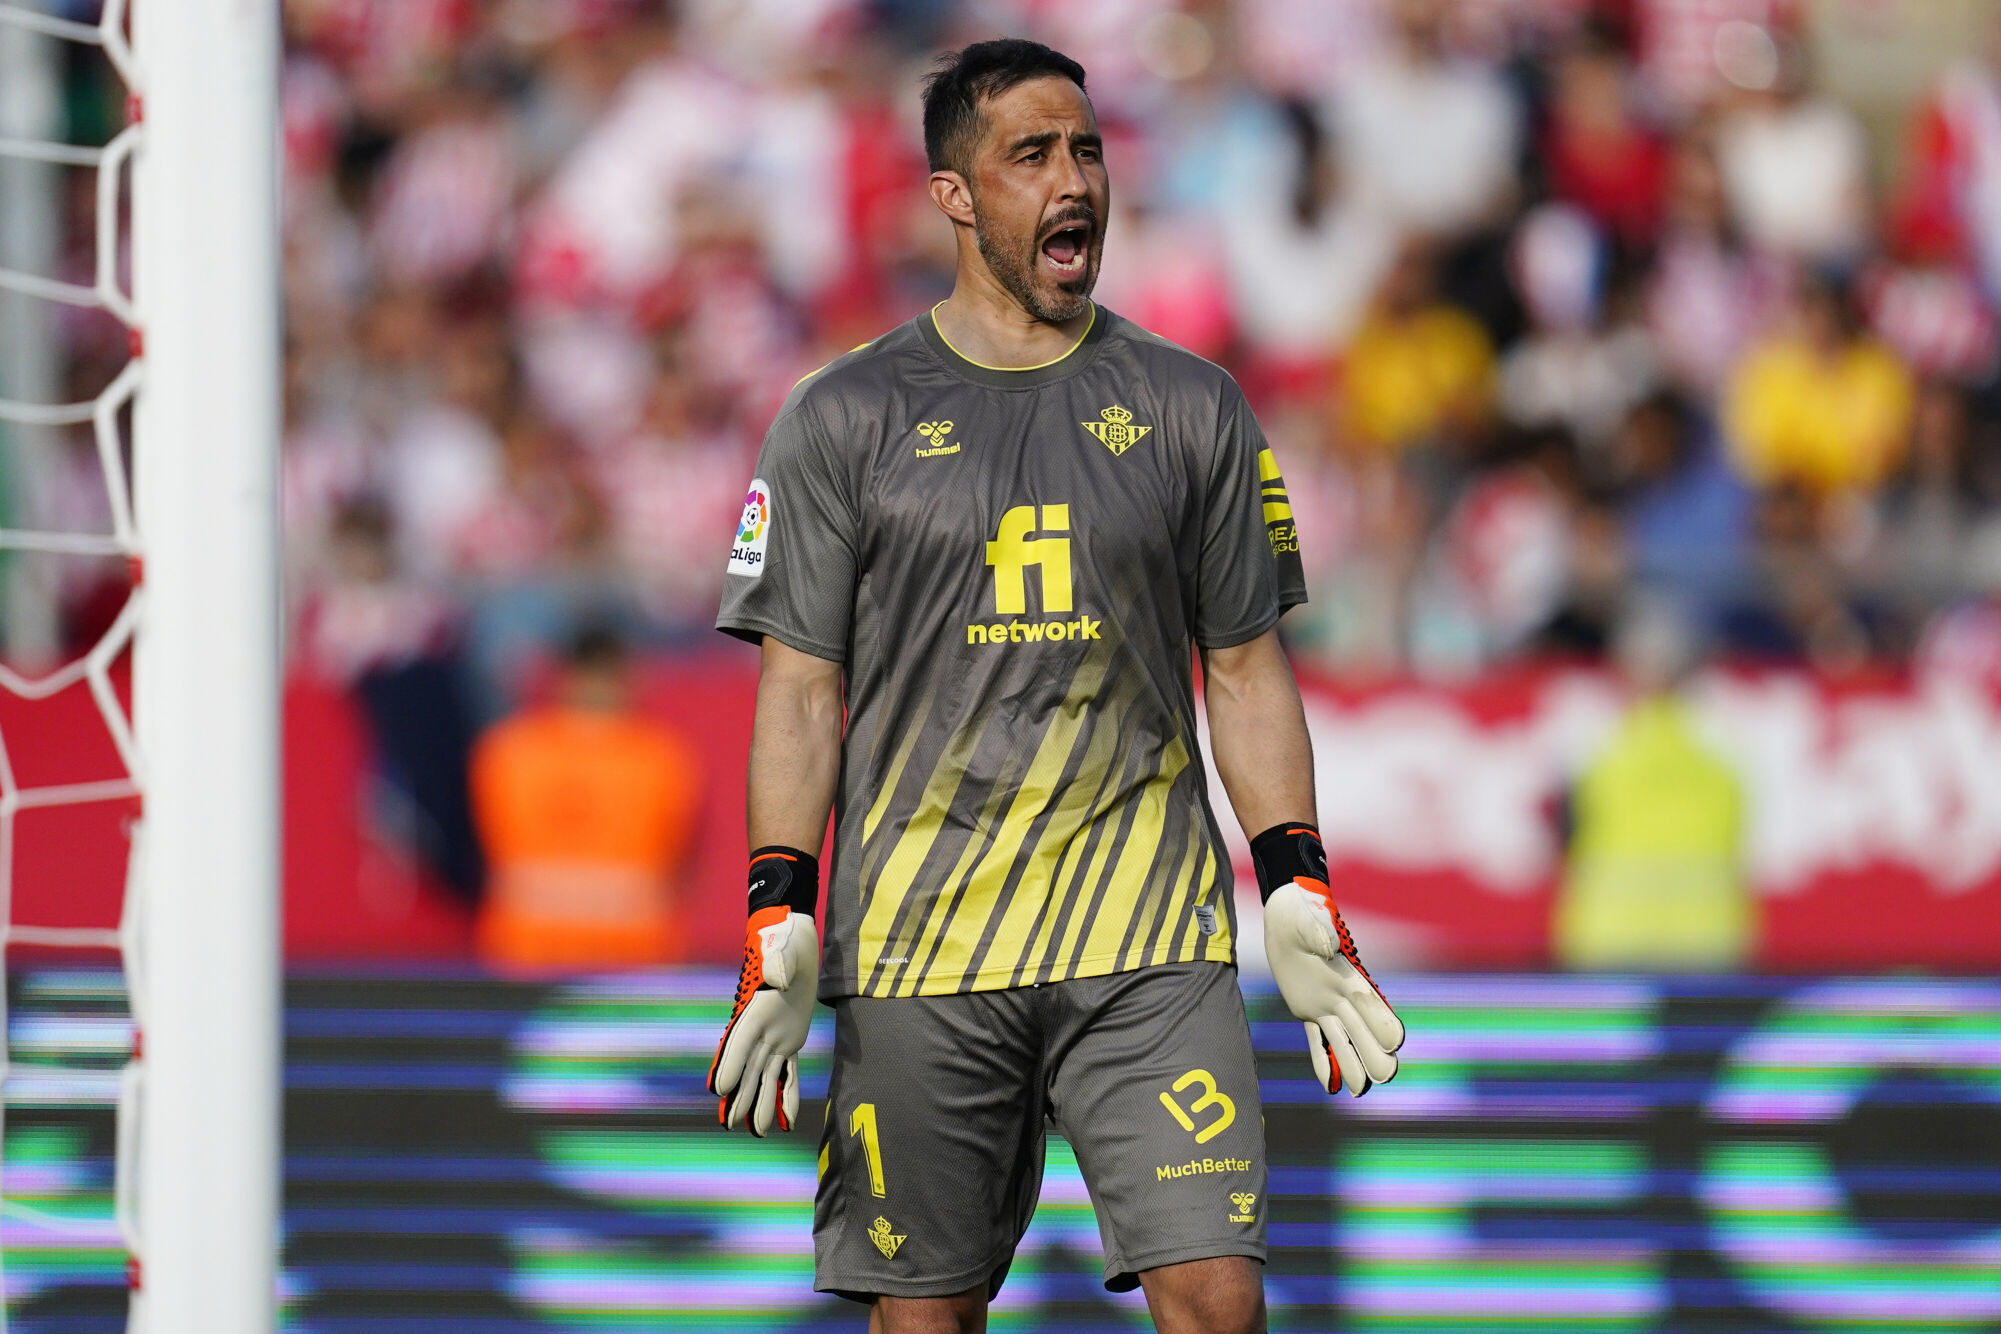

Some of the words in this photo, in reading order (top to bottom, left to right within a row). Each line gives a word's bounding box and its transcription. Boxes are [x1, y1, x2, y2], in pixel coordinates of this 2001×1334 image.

[915, 441, 961, 458] hummel
[985, 503, 1073, 614] fi
[967, 615, 1102, 645] network
[849, 1102, 886, 1199] 1
[1156, 1156, 1252, 1182] MuchBetter
